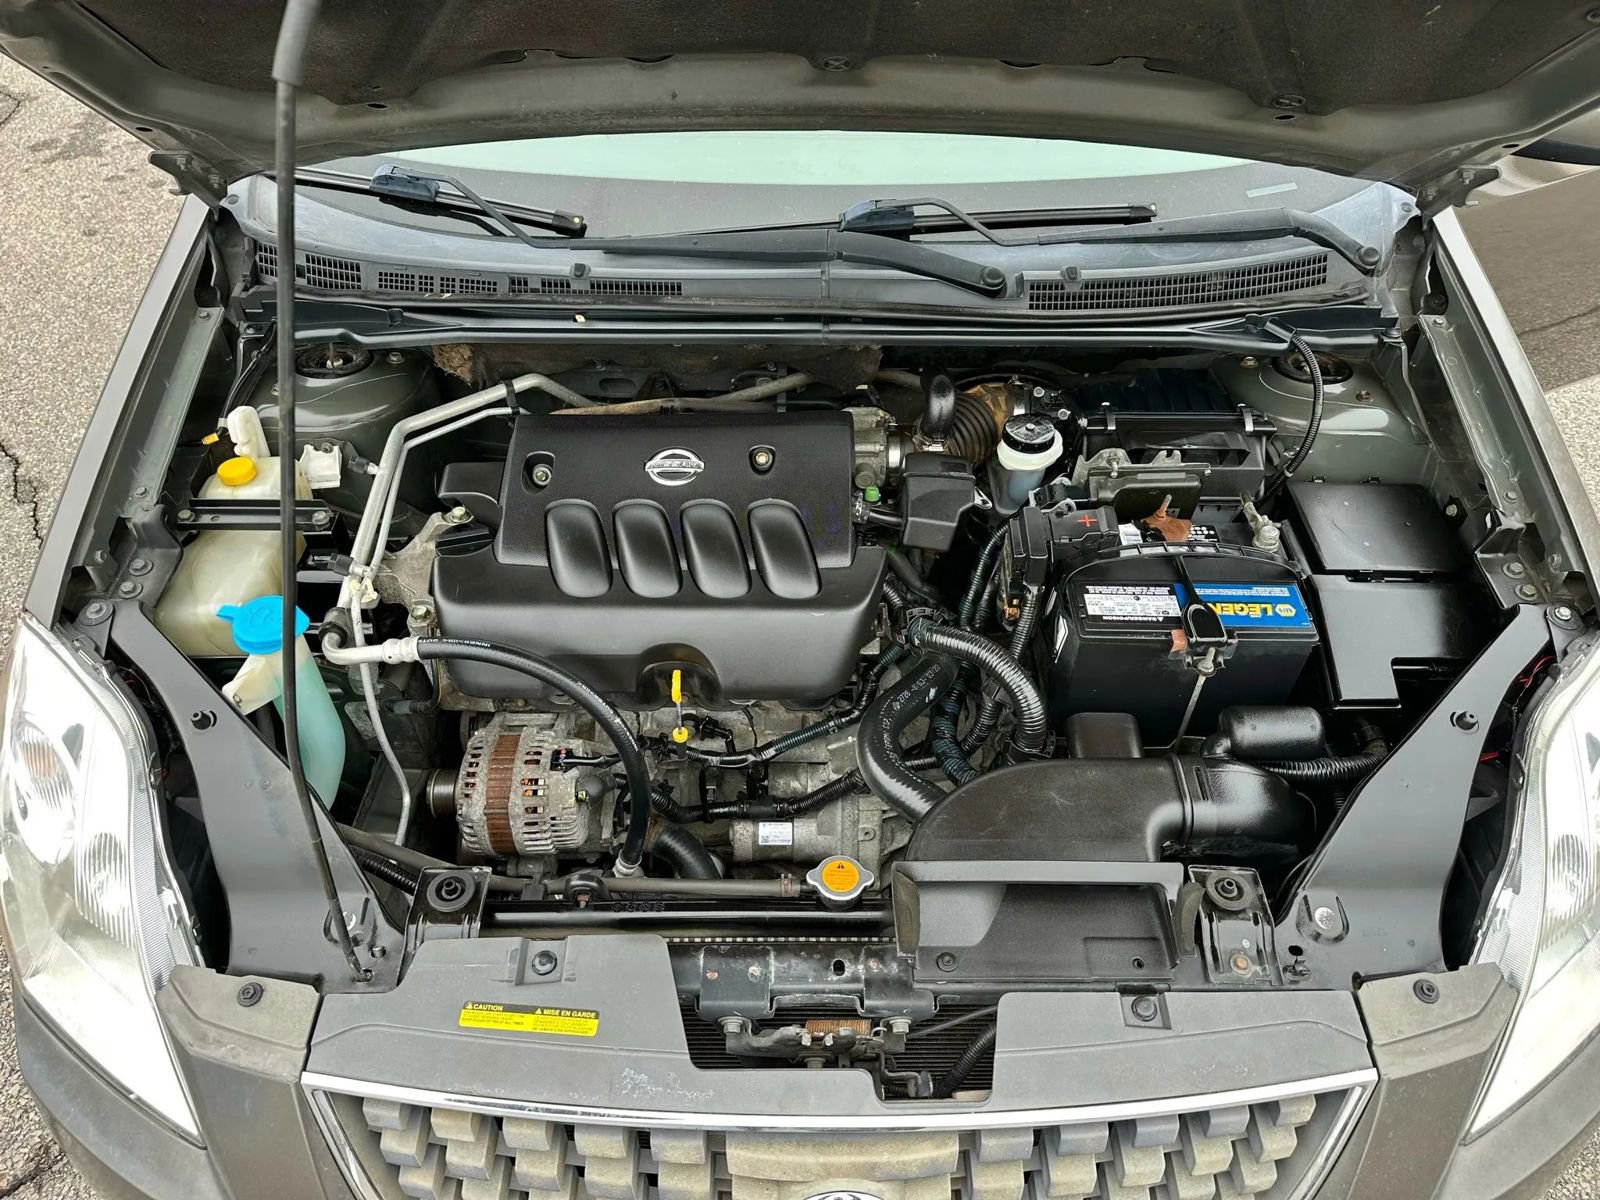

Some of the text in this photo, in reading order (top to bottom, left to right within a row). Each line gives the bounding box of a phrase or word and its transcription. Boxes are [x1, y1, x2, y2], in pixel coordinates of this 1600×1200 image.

[1206, 602, 1273, 616] LEGEN
[473, 1003, 504, 1012] CAUTION
[543, 1008, 597, 1019] MISE EN GARDE
